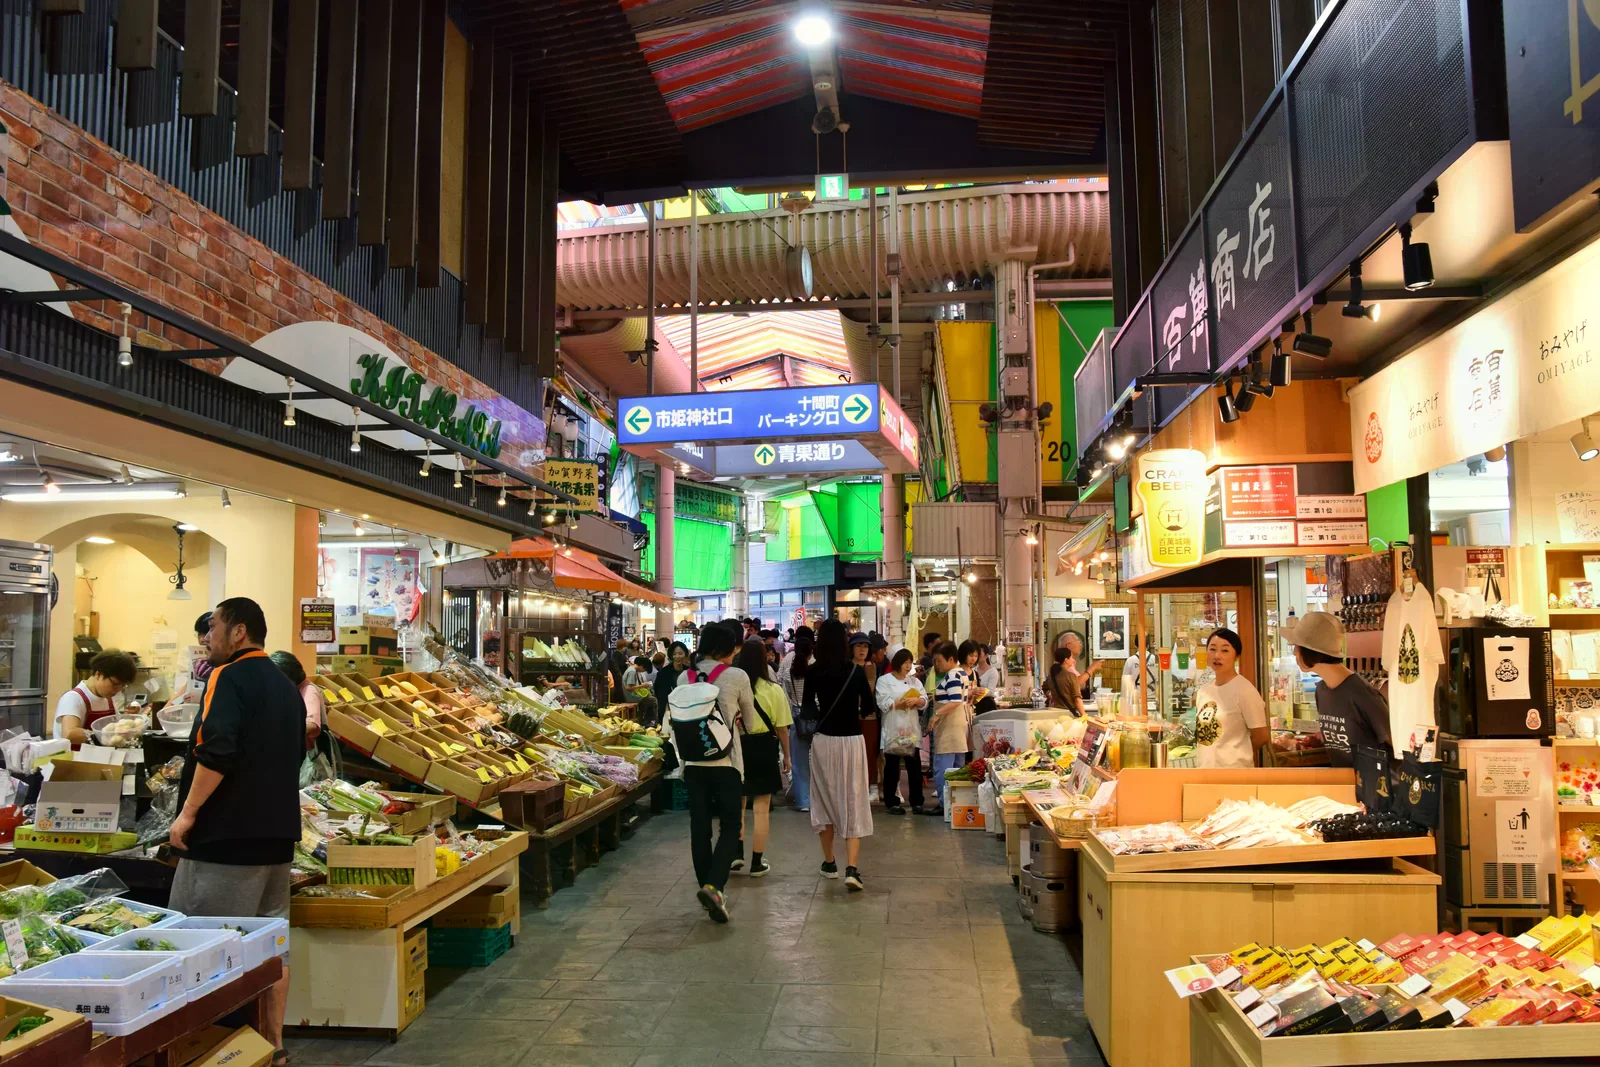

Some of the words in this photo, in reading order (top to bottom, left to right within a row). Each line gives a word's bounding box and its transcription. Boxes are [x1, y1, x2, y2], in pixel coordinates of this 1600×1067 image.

[1163, 182, 1275, 371] 百萬商店
[1540, 319, 1588, 361] おみやげ
[1537, 350, 1593, 384] OMIYAGE
[797, 395, 840, 412] 十間町
[1408, 391, 1440, 421] おみやげ
[655, 407, 733, 428] 市姫神社口
[757, 411, 840, 428] パーキング口
[1408, 416, 1443, 440] OMIYAGE
[778, 443, 846, 463] 青果通り
[1048, 441, 1071, 462] 20
[548, 466, 594, 480] 加賀野菜
[1145, 469, 1187, 480] CRAF
[846, 537, 855, 547] 13
[1159, 547, 1192, 556] BEER
[76, 1004, 91, 1014] 長田
